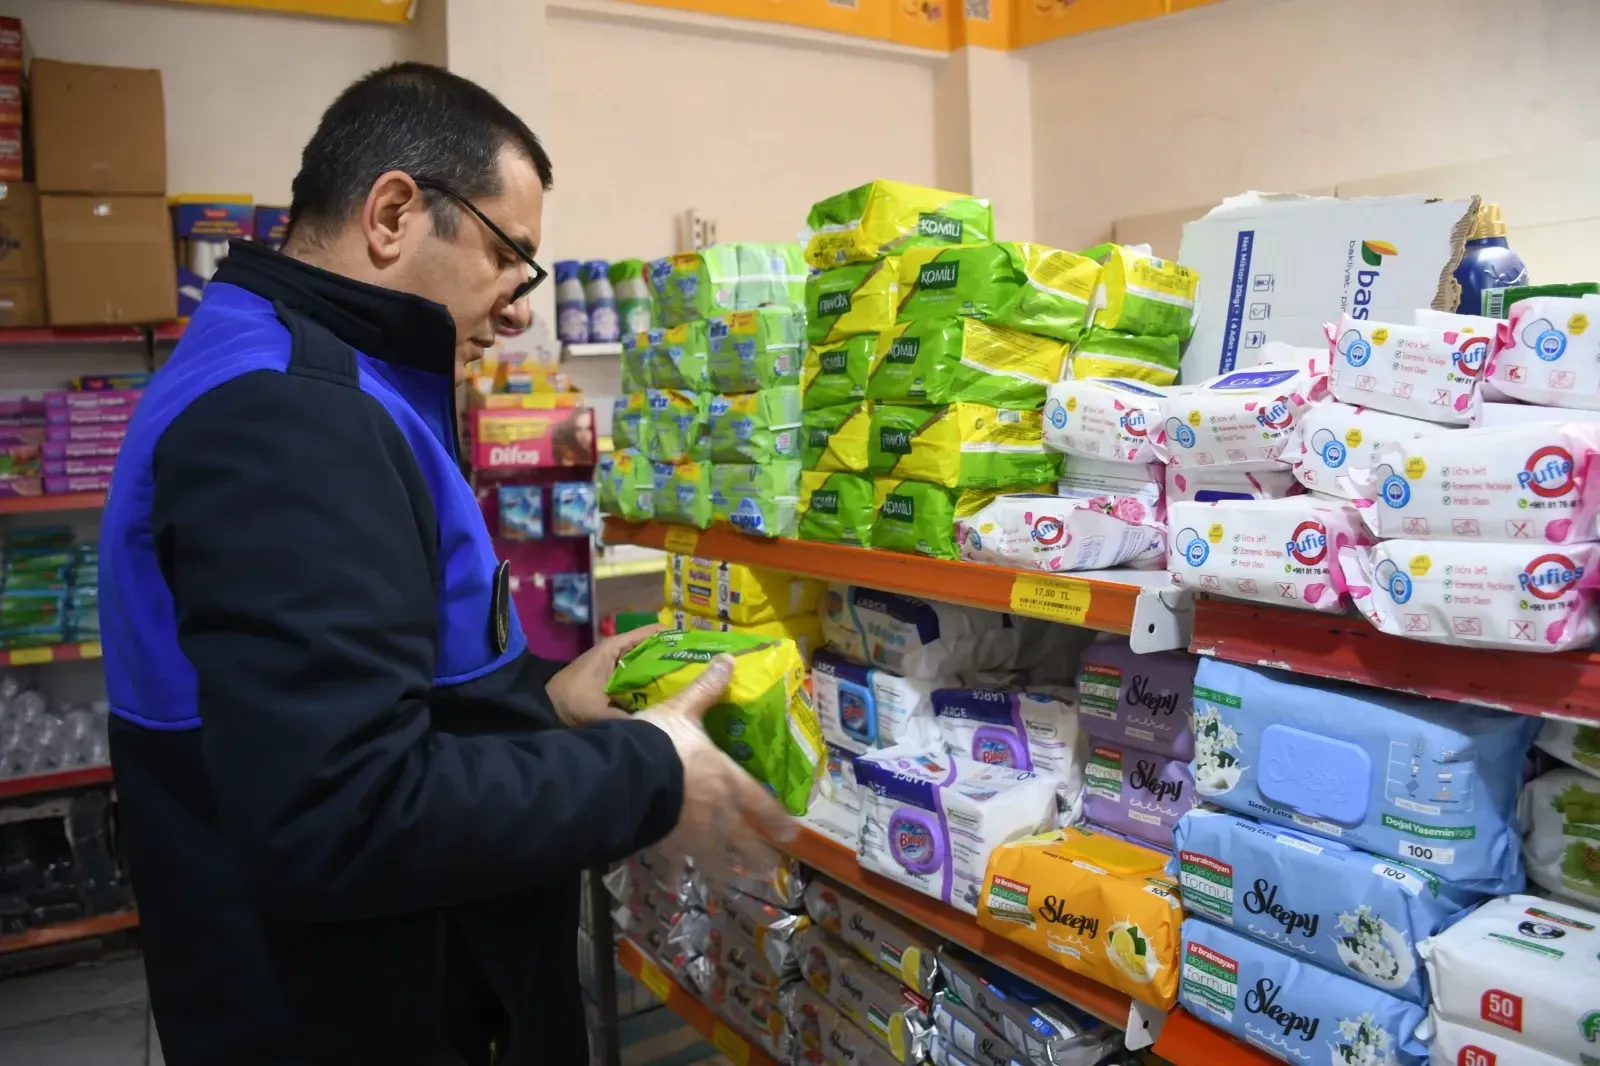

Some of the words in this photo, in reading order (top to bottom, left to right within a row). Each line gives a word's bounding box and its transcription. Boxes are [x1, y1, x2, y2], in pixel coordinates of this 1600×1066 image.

[1241, 236, 1249, 252] Net
[1344, 240, 1356, 289] bakliyat
[921, 265, 956, 286] KOMİLİ
[1227, 330, 1236, 349] Adet
[1035, 588, 1056, 598] 17,50
[1061, 591, 1070, 600] TL
[972, 690, 1005, 703] LARGE
[1126, 675, 1179, 716] Sleepy
[983, 751, 1008, 764] Bingo
[1130, 760, 1183, 801] Sleepy
[1248, 800, 1271, 813] Sleepy
[1273, 807, 1292, 819] Extra
[1235, 820, 1256, 832] Sleepy
[1258, 828, 1277, 839] Extra
[1385, 816, 1411, 831] Doğal
[1413, 824, 1454, 837] Yasemin
[900, 833, 926, 848] Bingo
[1182, 852, 1189, 860] iz
[1189, 855, 1230, 873] bırakmayan
[1408, 845, 1433, 860] 100
[1383, 867, 1406, 880] 100
[1152, 888, 1169, 897] 100
[1185, 874, 1230, 900] formül
[1039, 895, 1099, 939] Sleepy
[1243, 878, 1319, 938] Sleepy
[1198, 947, 1235, 970] bırakmayan
[1188, 967, 1234, 996] formül
[1244, 978, 1320, 1041] Sleepy
[1489, 993, 1514, 1018] 50
[1031, 1017, 1043, 1028] 30
[1245, 1022, 1312, 1060] extra
[1465, 1049, 1488, 1066] 50
